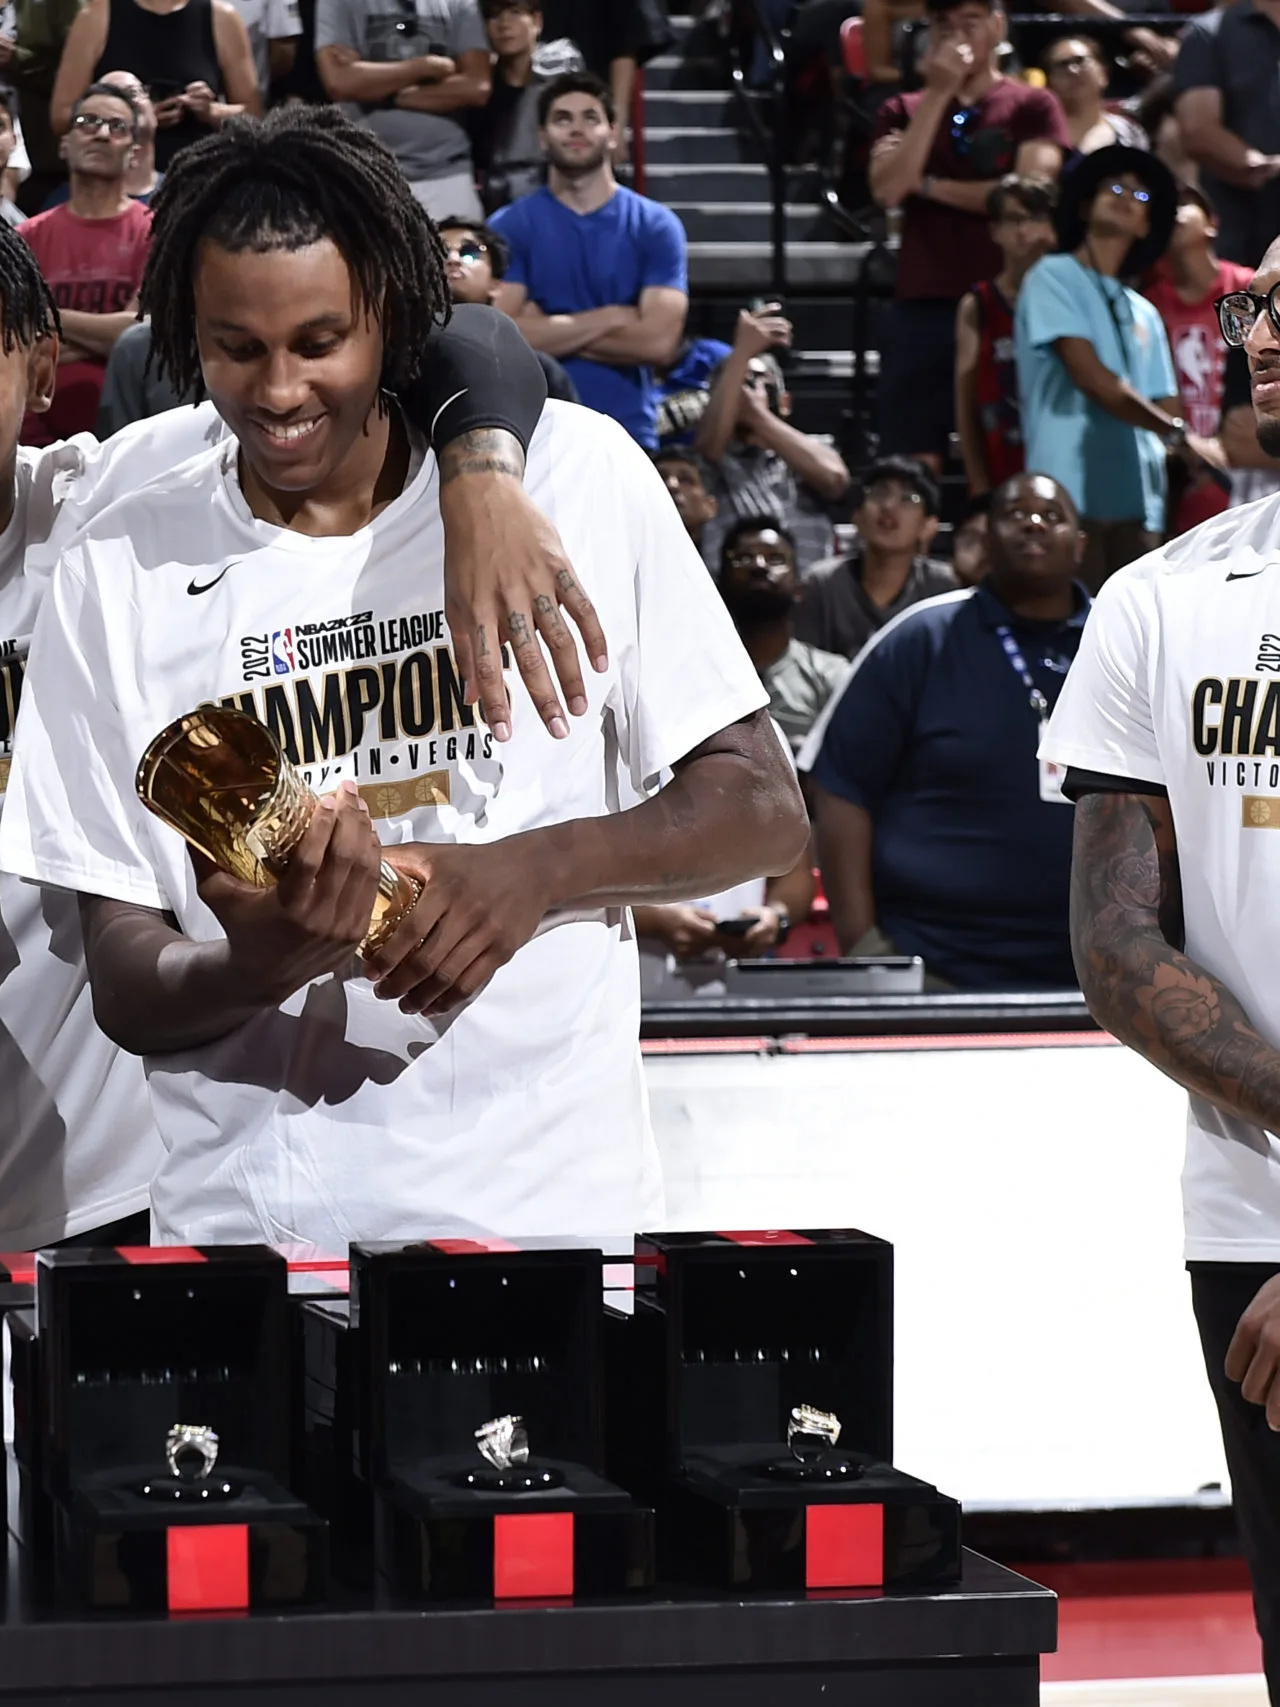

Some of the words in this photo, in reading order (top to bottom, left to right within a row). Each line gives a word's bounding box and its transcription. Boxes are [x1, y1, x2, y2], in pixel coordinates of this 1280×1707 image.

[295, 611, 373, 637] NBA2K23
[297, 625, 376, 671] SUMMER
[379, 610, 445, 657] LEAGUE
[240, 633, 271, 682] 2022
[353, 750, 382, 778] IN
[408, 732, 494, 771] VEGAS
[1206, 761, 1280, 788] VICTO
